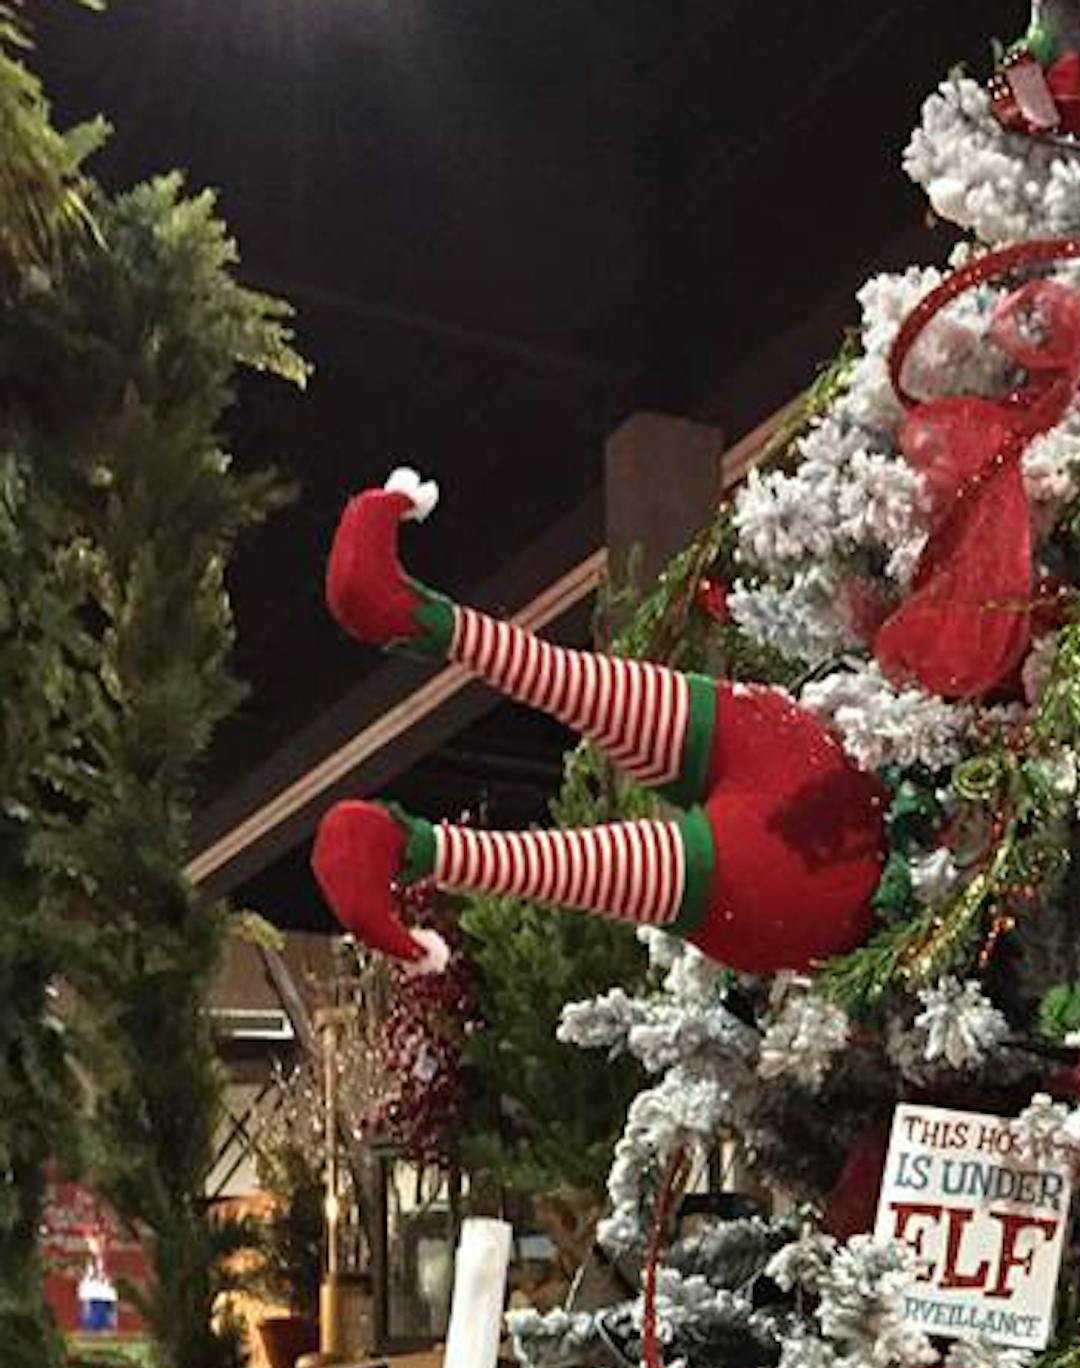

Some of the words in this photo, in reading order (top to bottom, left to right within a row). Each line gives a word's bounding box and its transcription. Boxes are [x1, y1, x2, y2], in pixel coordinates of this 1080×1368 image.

[904, 1115, 968, 1149] THIS
[895, 1152, 932, 1190] IS
[942, 1161, 1063, 1212] UNDER
[890, 1202, 1058, 1300] ELF
